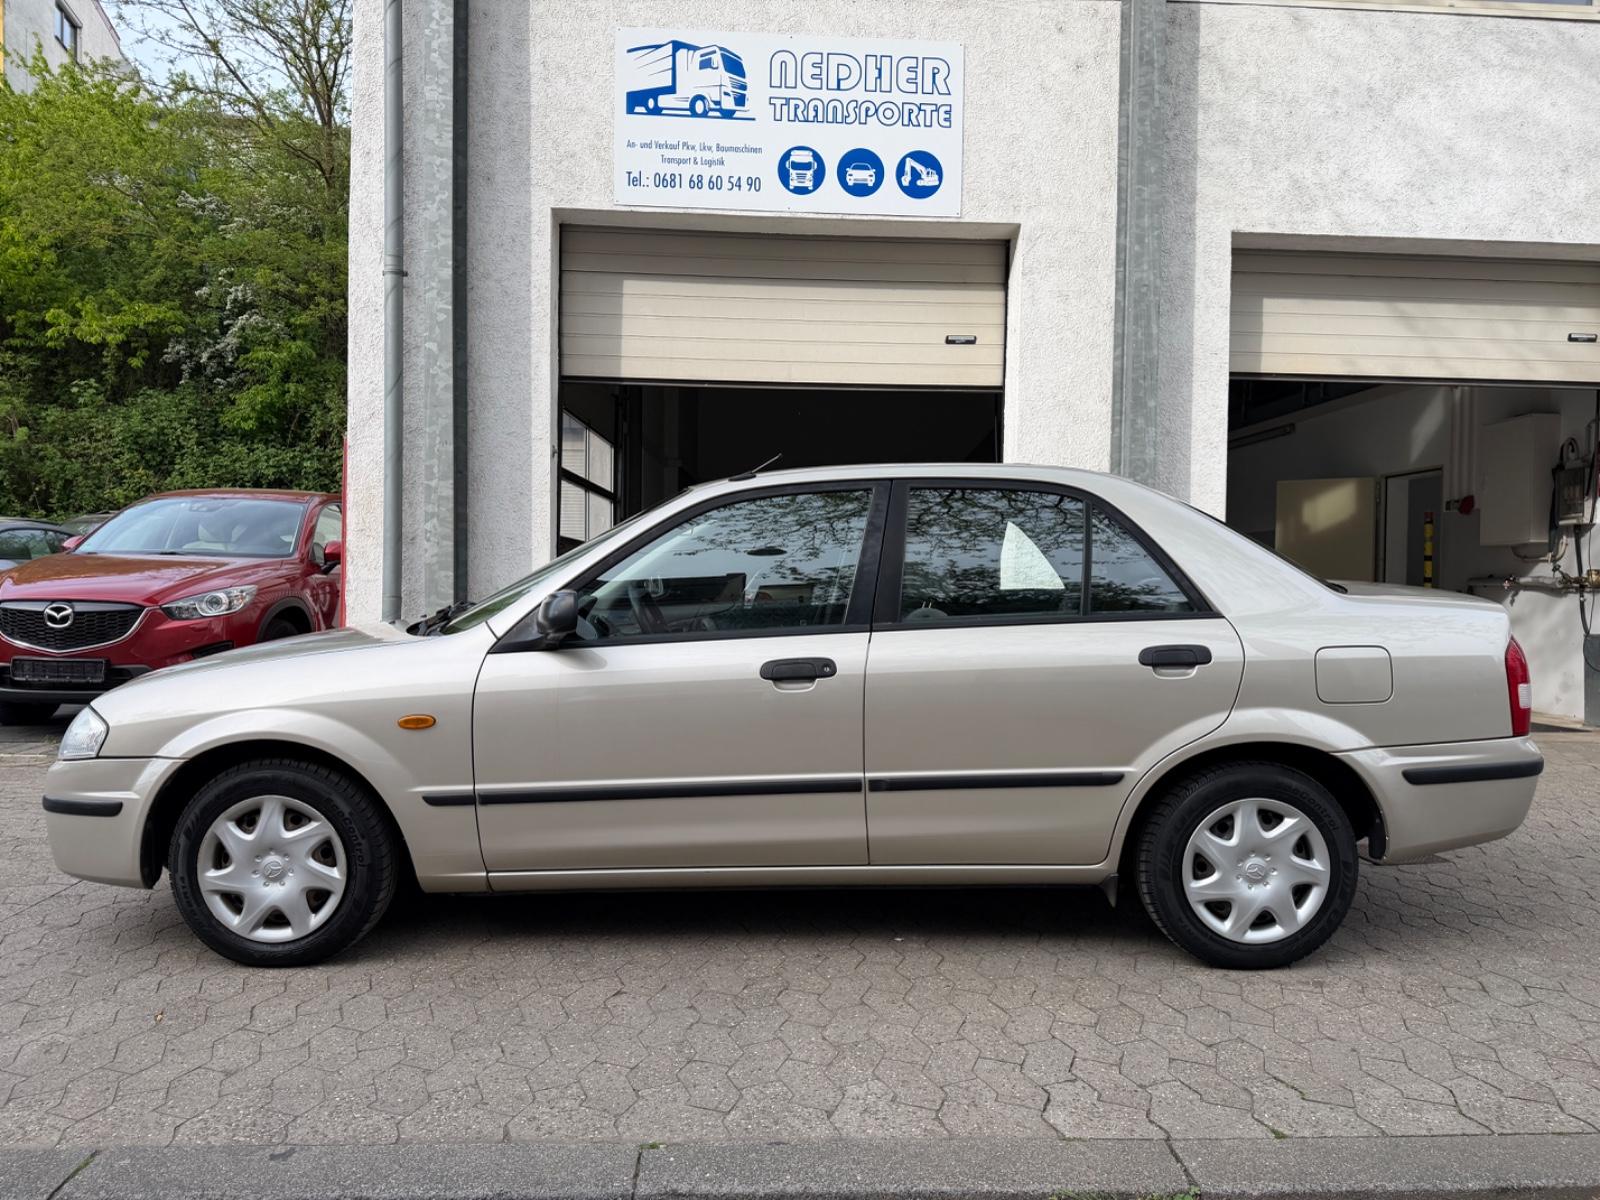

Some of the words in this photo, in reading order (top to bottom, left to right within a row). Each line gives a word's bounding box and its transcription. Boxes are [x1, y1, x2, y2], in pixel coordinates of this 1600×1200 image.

[769, 49, 952, 96] NEDHER
[769, 96, 952, 129] TRANSPORTE
[639, 139, 653, 150] und
[653, 140, 681, 151] Verkauf
[681, 140, 698, 152] Pkw,
[699, 142, 714, 154] Lkw,
[715, 143, 763, 155] Baumaschinen
[660, 154, 692, 167] Transport
[692, 156, 699, 166] &
[700, 156, 726, 168] Logistik
[625, 170, 650, 188] Tel.:
[653, 171, 682, 189] 0681
[688, 173, 704, 190] 68
[707, 174, 724, 191] 60
[726, 175, 742, 192] 54
[746, 176, 762, 193] 90
